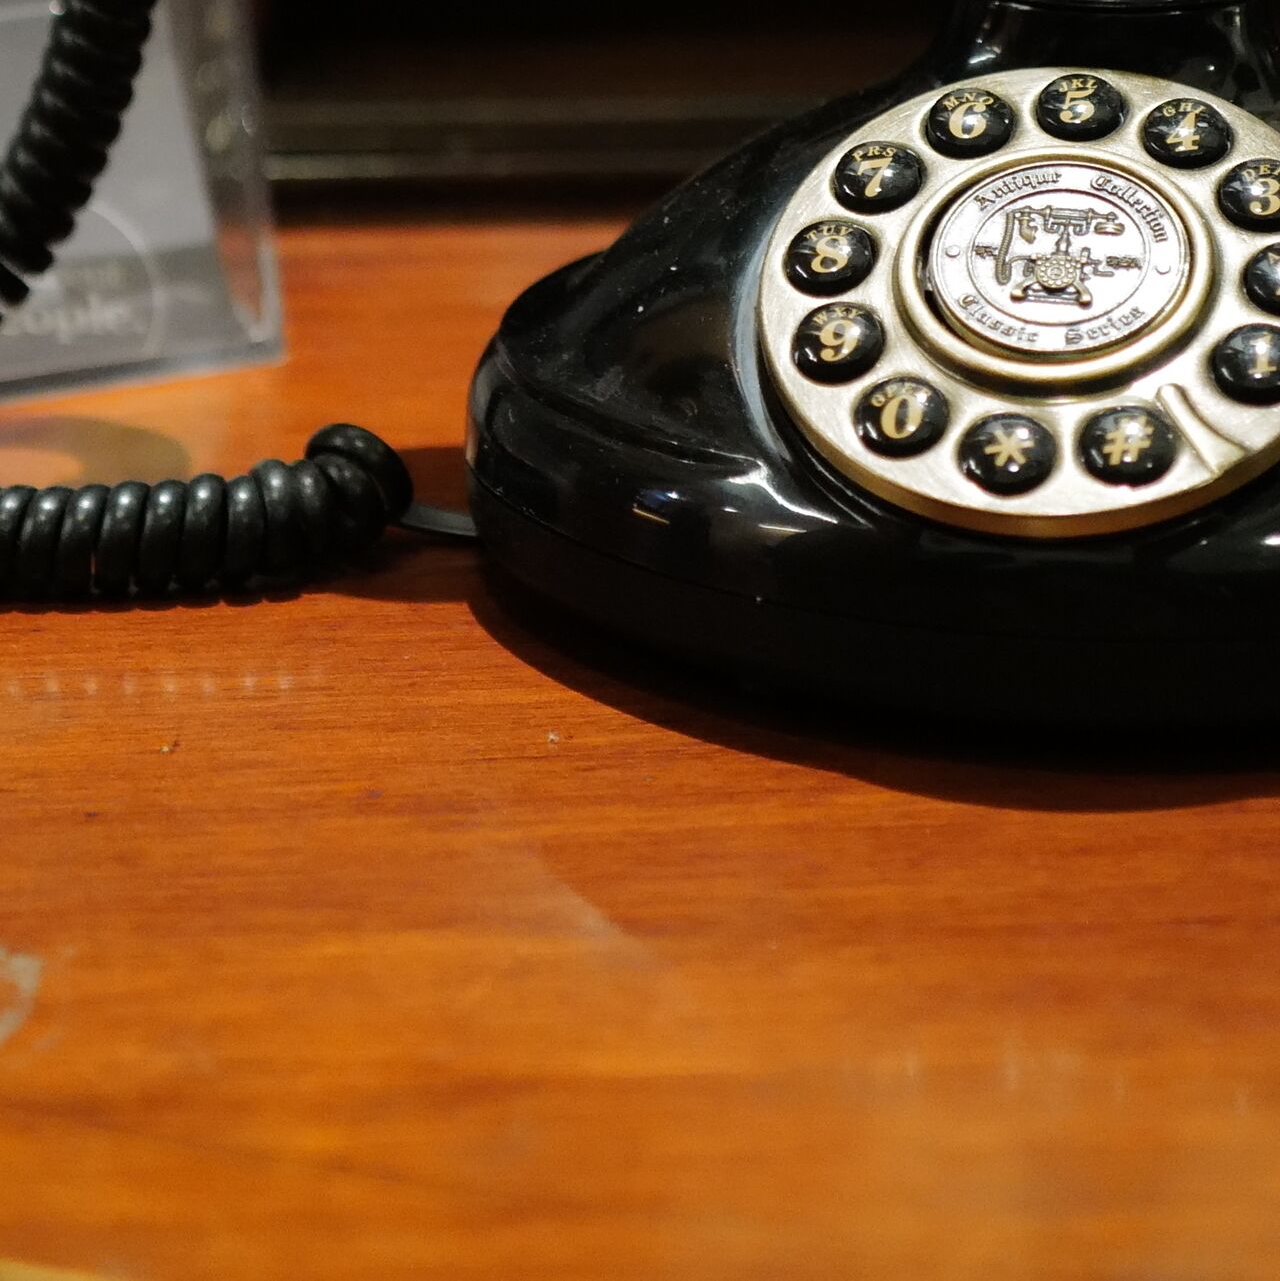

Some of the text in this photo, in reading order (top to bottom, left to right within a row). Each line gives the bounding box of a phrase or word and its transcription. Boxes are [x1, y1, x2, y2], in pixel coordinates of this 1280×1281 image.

[942, 90, 995, 111] MNO
[1058, 77, 1098, 93] JKL
[948, 101, 987, 140] 6
[1058, 87, 1095, 124] 5
[1166, 110, 1201, 153] 4
[851, 146, 897, 163] PRS
[857, 156, 893, 197] 7
[806, 225, 854, 244] TUV
[810, 234, 850, 273] 8
[819, 318, 860, 362] 9
[1247, 331, 1277, 378] 1
[880, 394, 923, 440] 0
